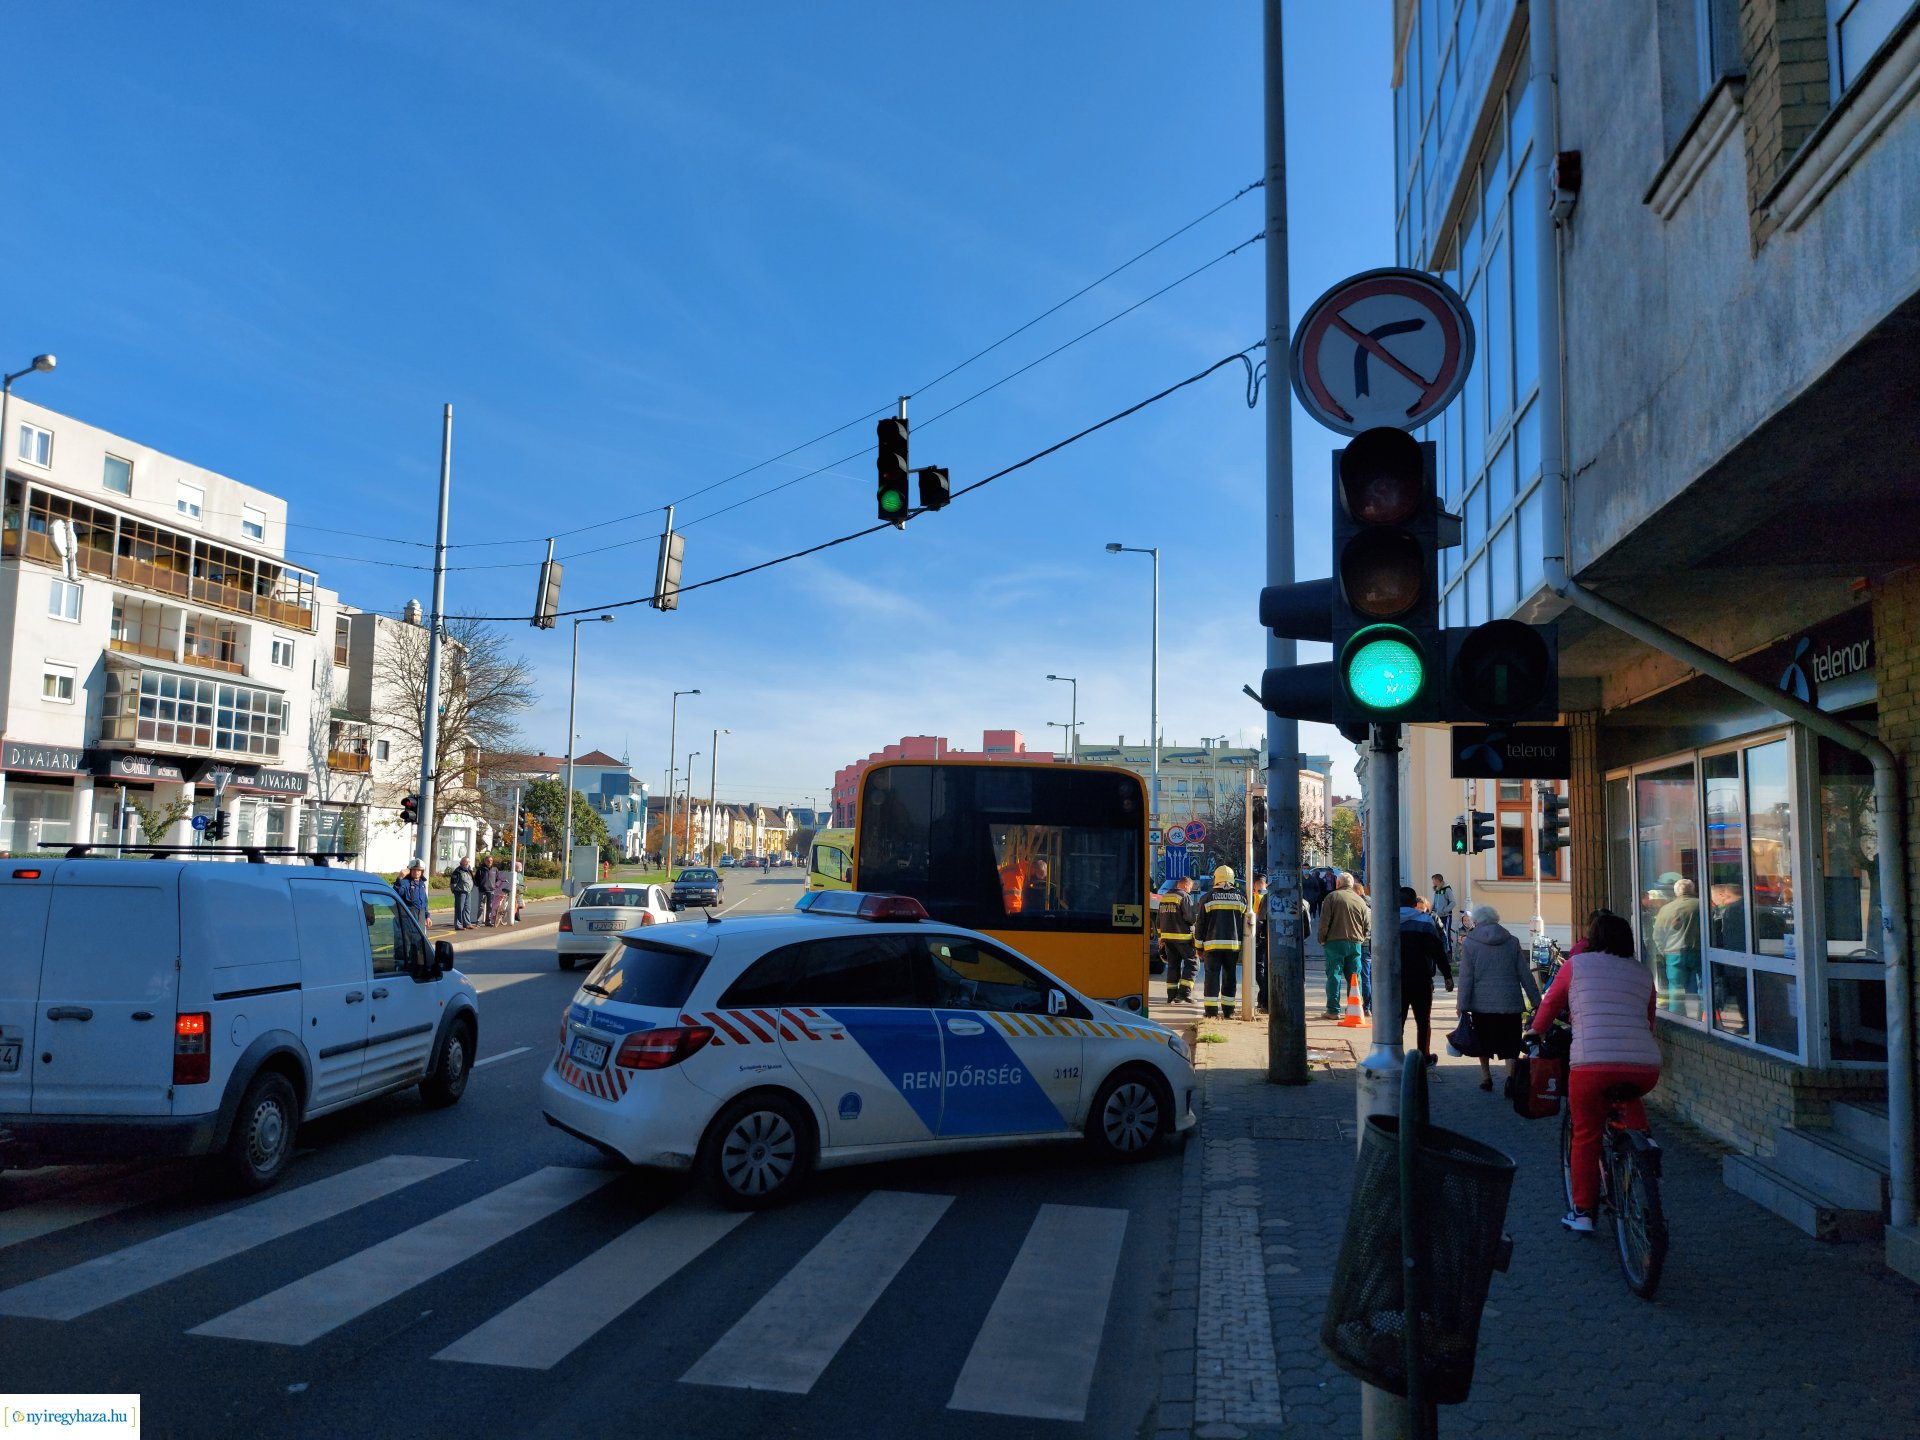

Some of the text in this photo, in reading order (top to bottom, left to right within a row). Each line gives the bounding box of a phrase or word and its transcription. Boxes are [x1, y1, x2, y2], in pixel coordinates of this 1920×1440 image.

[1812, 640, 1869, 682] telenor
[1507, 743, 1557, 757] telenor
[902, 1064, 1022, 1089] RENDŐRSÉG
